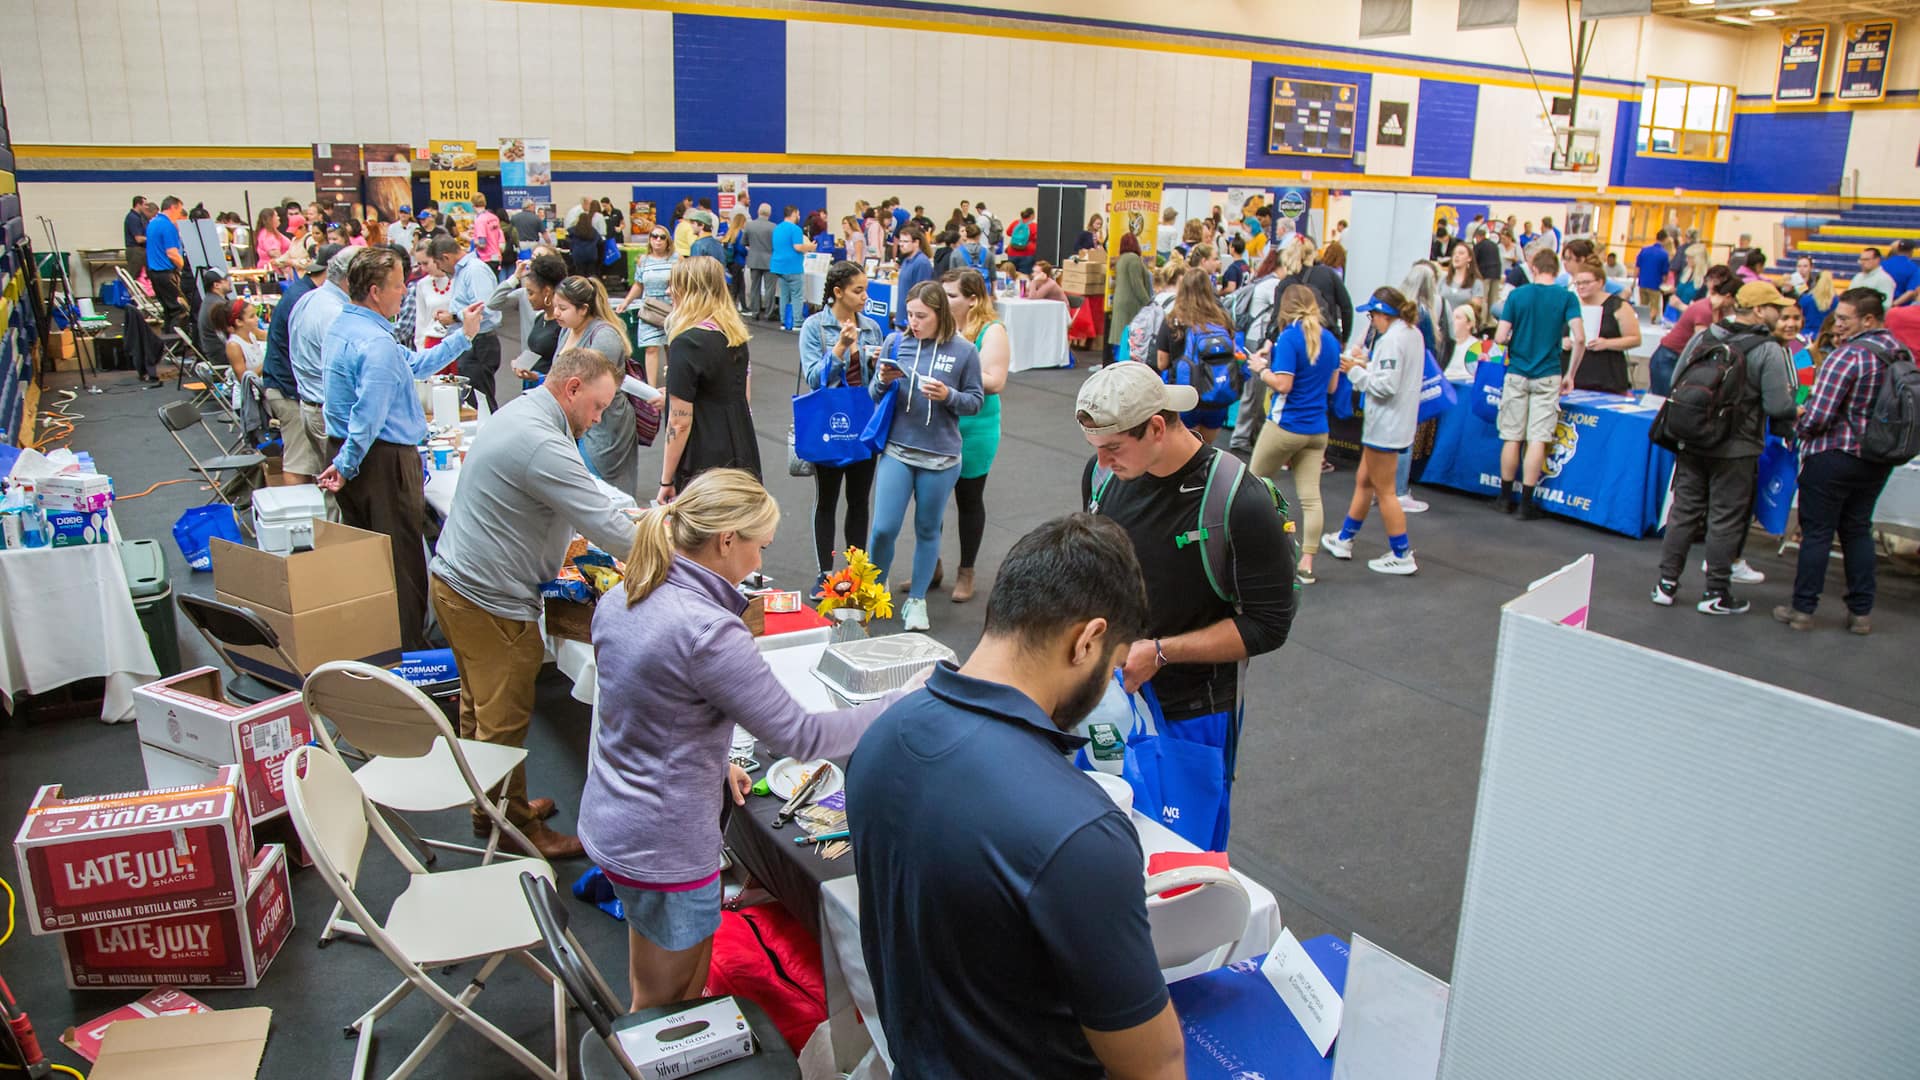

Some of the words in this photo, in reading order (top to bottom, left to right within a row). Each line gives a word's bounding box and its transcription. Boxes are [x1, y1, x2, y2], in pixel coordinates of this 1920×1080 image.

[440, 180, 470, 190] YOUR
[1117, 179, 1133, 188] YOUR
[1134, 180, 1145, 188] ONE
[1146, 180, 1160, 189] STOP
[440, 191, 470, 200] MENU
[1124, 190, 1140, 198] SHOP
[1141, 190, 1151, 198] FOR
[1113, 200, 1160, 212] GLUTEN-FREE
[1568, 413, 1600, 427] HOME
[1566, 494, 1592, 511] LIFE
[153, 873, 196, 888] SNACKS
[81, 907, 132, 923] MULTIGRAIN
[133, 902, 172, 917] TORTILLA
[173, 898, 198, 911] CHIPS
[171, 950, 209, 960] SNACKS
[109, 974, 152, 984] MULTIGRAIN
[154, 974, 188, 984] TORTILLA
[189, 974, 211, 984] CHIPS
[666, 1014, 686, 1025] Silver
[659, 1041, 682, 1053] VINYL
[685, 1031, 717, 1045] GLOVES
[710, 1049, 733, 1061] GLOVES
[1193, 1030, 1238, 1072] JOHNSON
[655, 1061, 681, 1079] Silver
